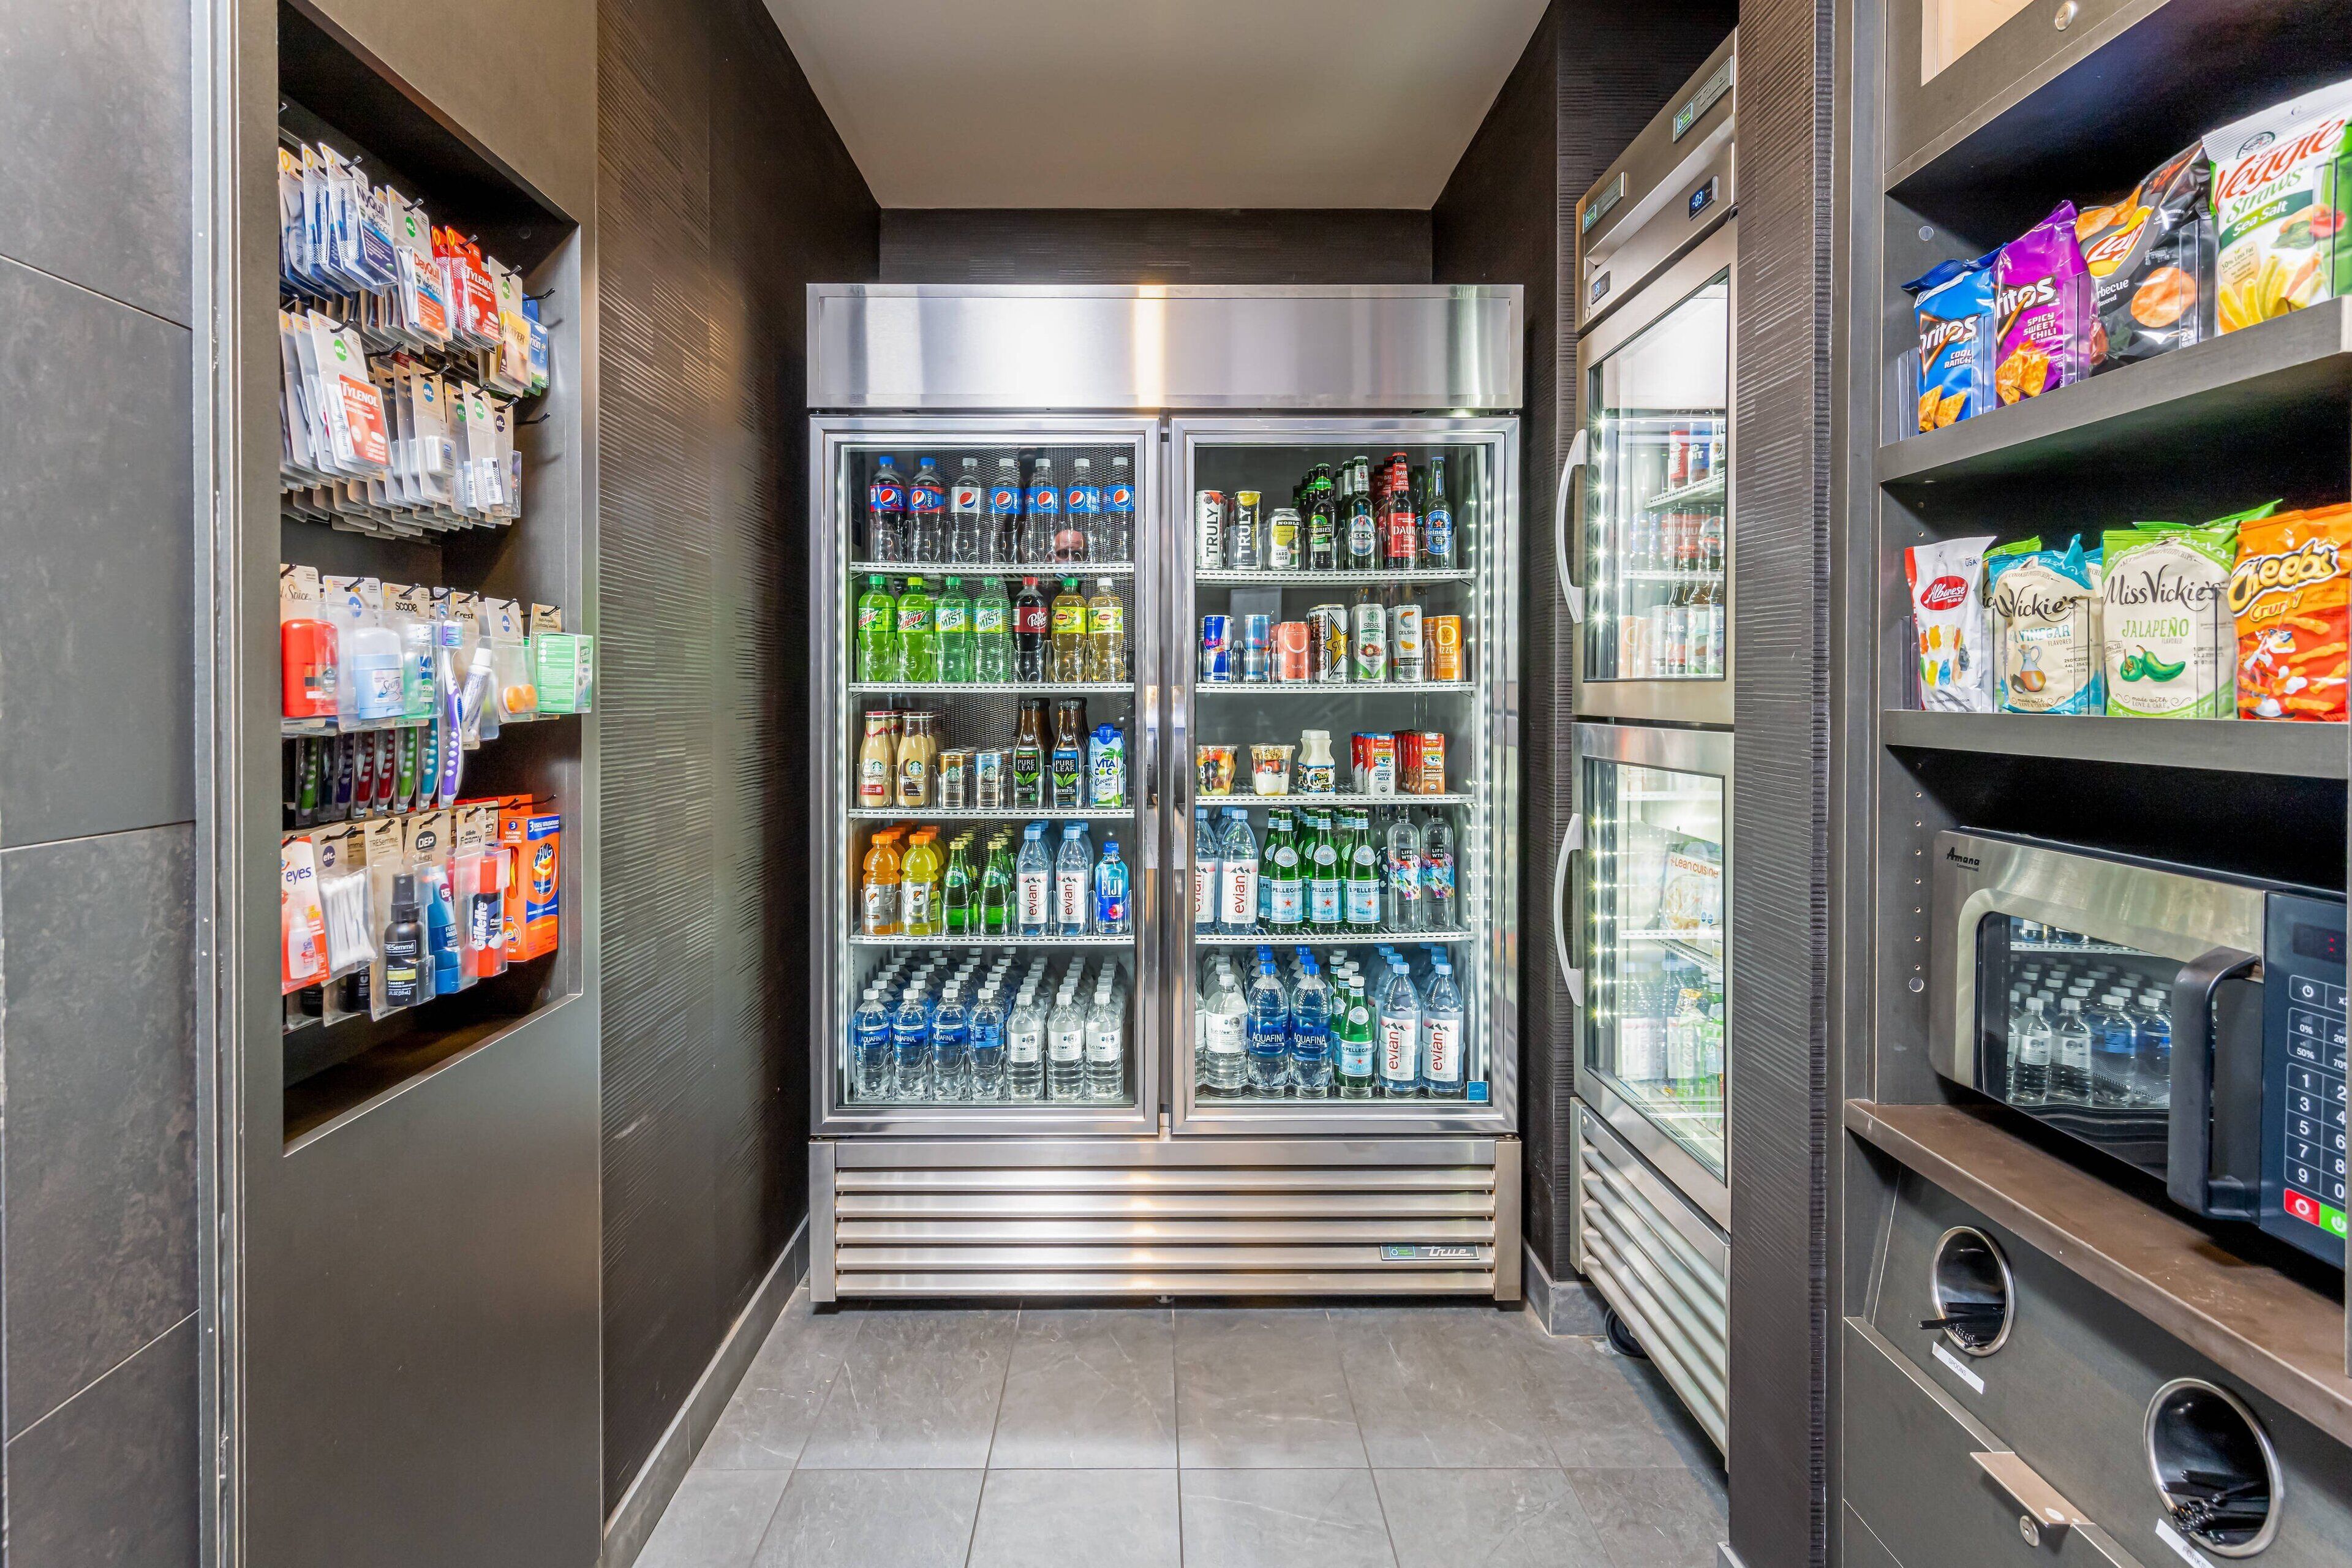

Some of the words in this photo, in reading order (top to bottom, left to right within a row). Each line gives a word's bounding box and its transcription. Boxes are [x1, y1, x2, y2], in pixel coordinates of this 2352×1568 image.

[2214, 119, 2345, 214] Veggie
[356, 185, 386, 218] NyQuil
[2226, 167, 2304, 225] Straws
[2233, 214, 2260, 237] Sea
[2260, 200, 2288, 222] Salt
[413, 252, 441, 280] DayQuil
[467, 267, 495, 292] TYLENOL
[2097, 278, 2129, 298] rbecue
[1997, 277, 2056, 319] ritos
[2098, 295, 2117, 307] lavored
[2023, 320, 2056, 336] SWEET
[2027, 312, 2054, 326] SPICY
[2030, 328, 2057, 341] CHILI
[1945, 357, 1972, 369] RANCH
[1950, 350, 1972, 359] COOL
[341, 380, 379, 407] TYLENOL
[1206, 508, 1218, 557] TRULY
[1238, 507, 1251, 554] TRULY
[1965, 559, 1977, 567] USA
[2228, 541, 2336, 613] Cheetos
[1924, 582, 1966, 603] Albanese
[2104, 575, 2144, 606] Miss
[2143, 564, 2220, 612] Vickie's
[454, 610, 473, 620] Crest
[941, 613, 963, 629] MIST
[979, 614, 1000, 629] MIST
[2122, 616, 2189, 639] JALAPEÑO
[2048, 638, 2072, 647] FLAVORED
[1096, 758, 1115, 767] VITA
[529, 821, 534, 833] 3
[418, 837, 435, 849] DEP
[460, 834, 483, 845] Foamy
[1947, 846, 1980, 866] Amana
[286, 866, 312, 884] eyes
[1101, 880, 1123, 896] FIJI
[1233, 874, 1245, 914] evian
[1027, 884, 1037, 916] evian
[1064, 884, 1073, 915] evian
[473, 900, 489, 951] Gillette
[1253, 1033, 1285, 1044] AQUAFINA
[1294, 1033, 1326, 1044] AQUAFINA
[2300, 1023, 2313, 1035] 0%
[1387, 1031, 1399, 1069] evian
[1431, 1031, 1443, 1071] evian
[2297, 1047, 2315, 1060] 50%
[2302, 1073, 2309, 1088] 1
[2337, 1085, 2346, 1101] 2
[2300, 1096, 2310, 1112] 3
[2336, 1109, 2346, 1125] 4
[2299, 1121, 2309, 1135] 5
[2335, 1134, 2345, 1149] 6
[2299, 1144, 2309, 1158] 7
[2335, 1158, 2345, 1174] 8
[2298, 1168, 2309, 1183] 9
[2334, 1182, 2345, 1198] 0
[1948, 1357, 1967, 1376] SPOONS
